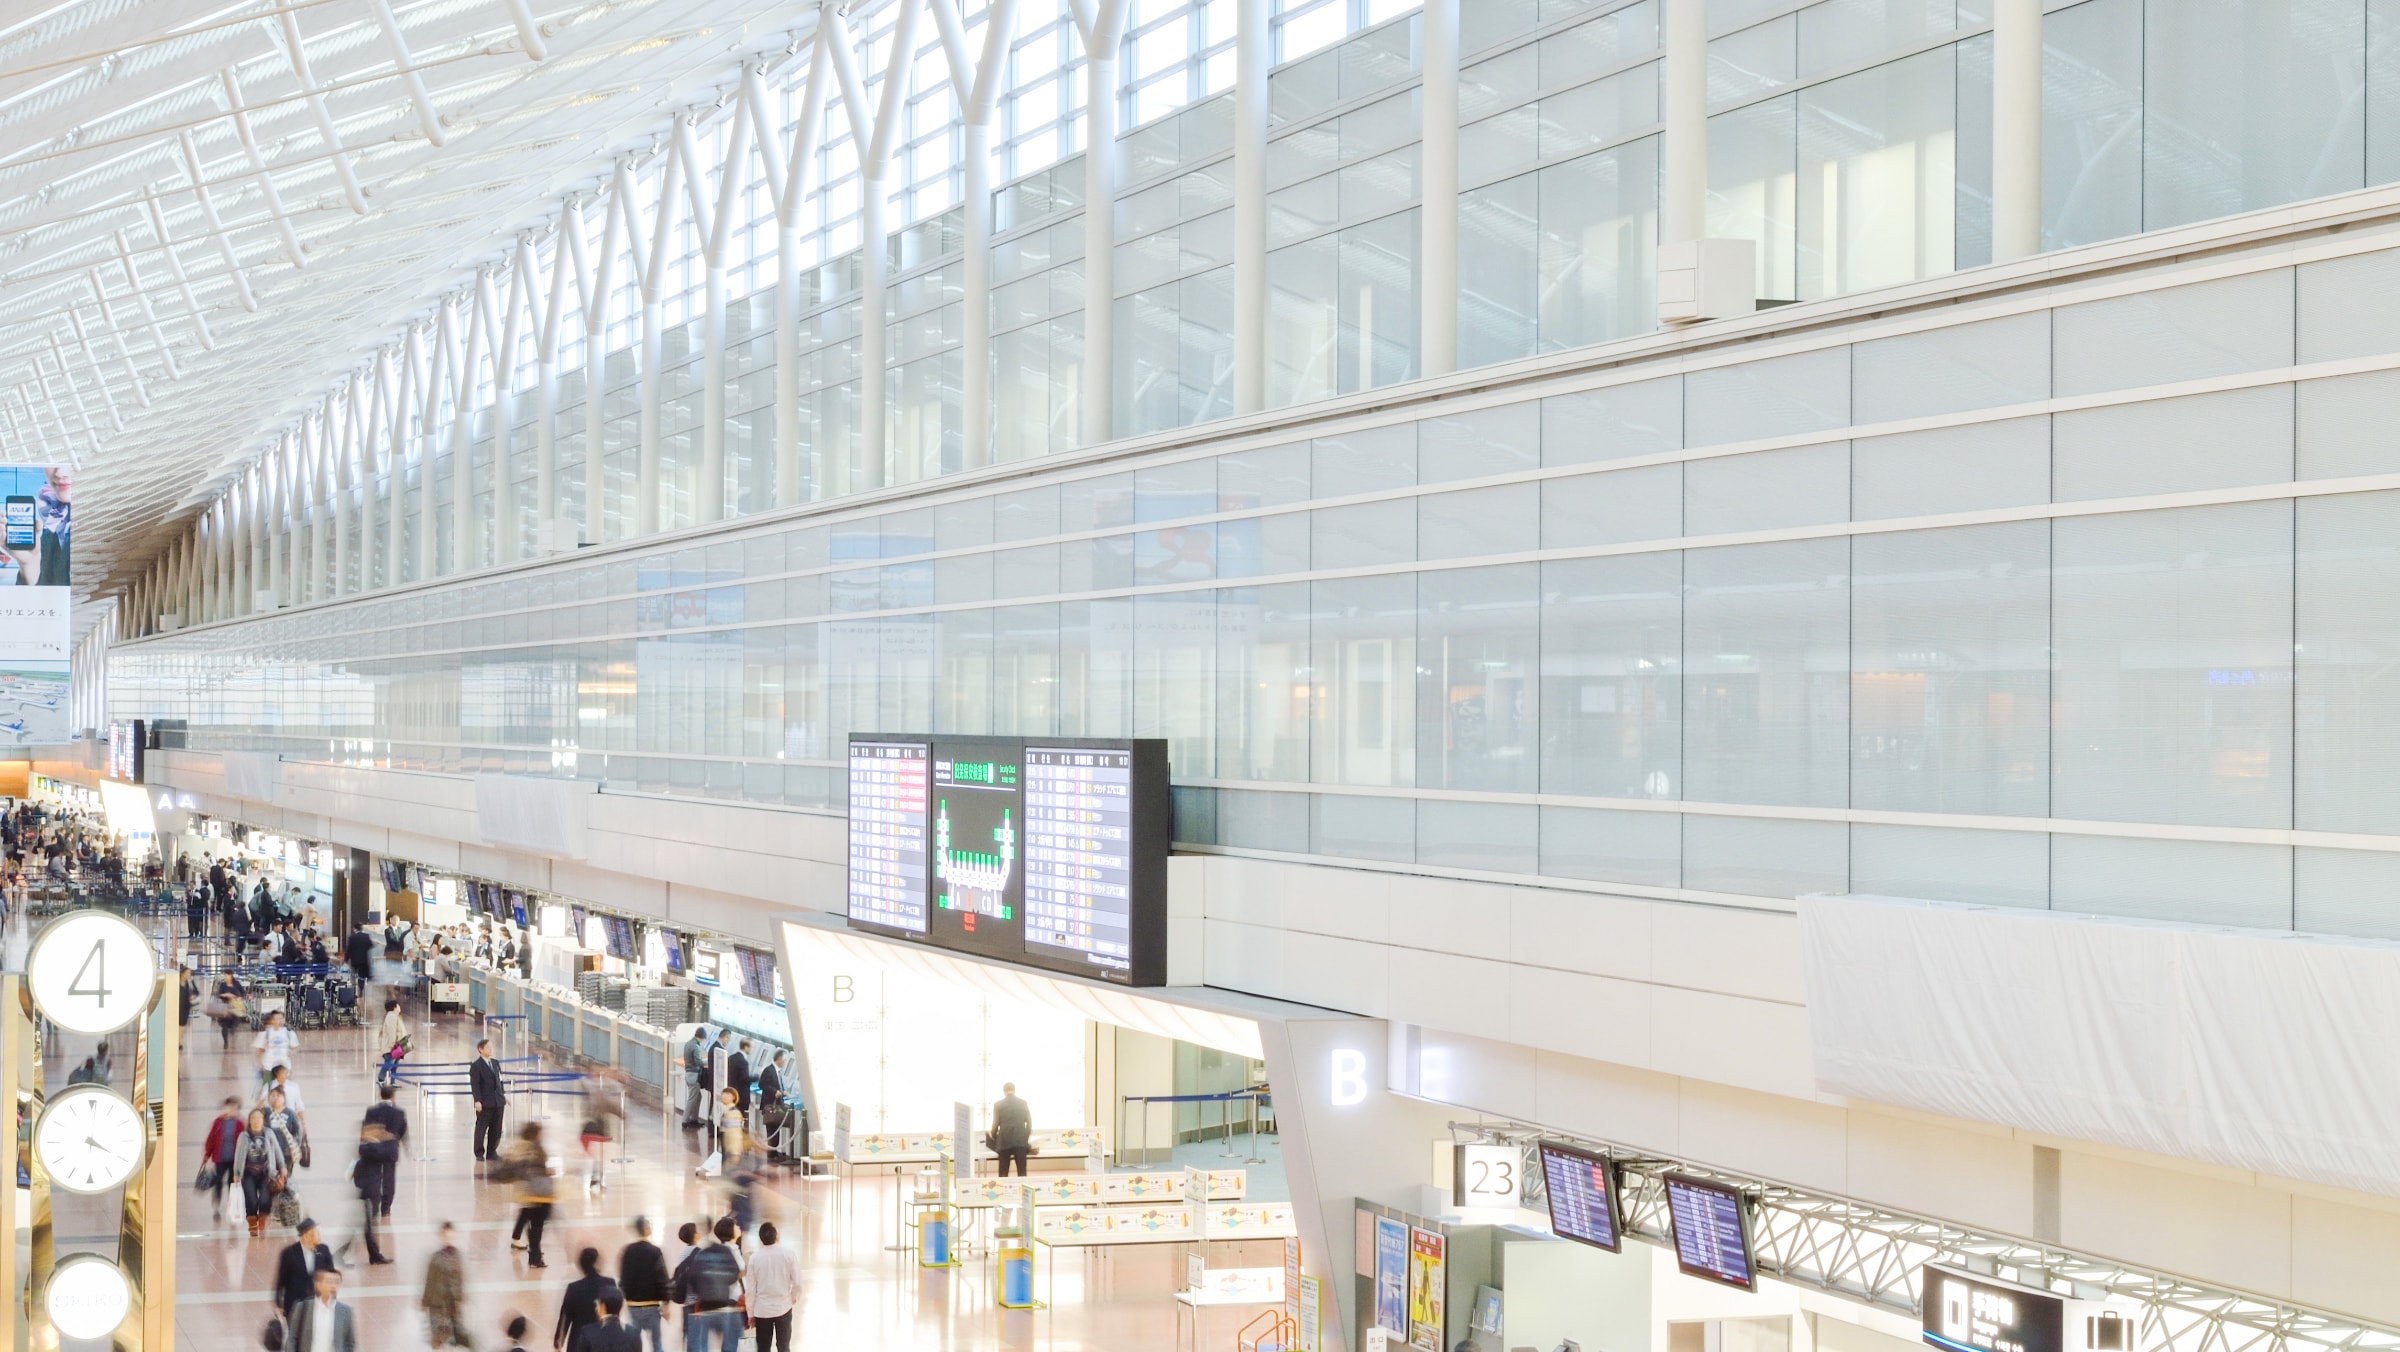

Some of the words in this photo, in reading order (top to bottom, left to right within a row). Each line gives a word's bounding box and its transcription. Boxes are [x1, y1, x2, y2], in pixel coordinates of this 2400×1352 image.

[157, 793, 173, 810] A
[334, 858, 346, 870] 13
[67, 938, 113, 1009] 4
[833, 974, 855, 1004] B
[1330, 1048, 1367, 1106] B
[1471, 1160, 1514, 1196] 23
